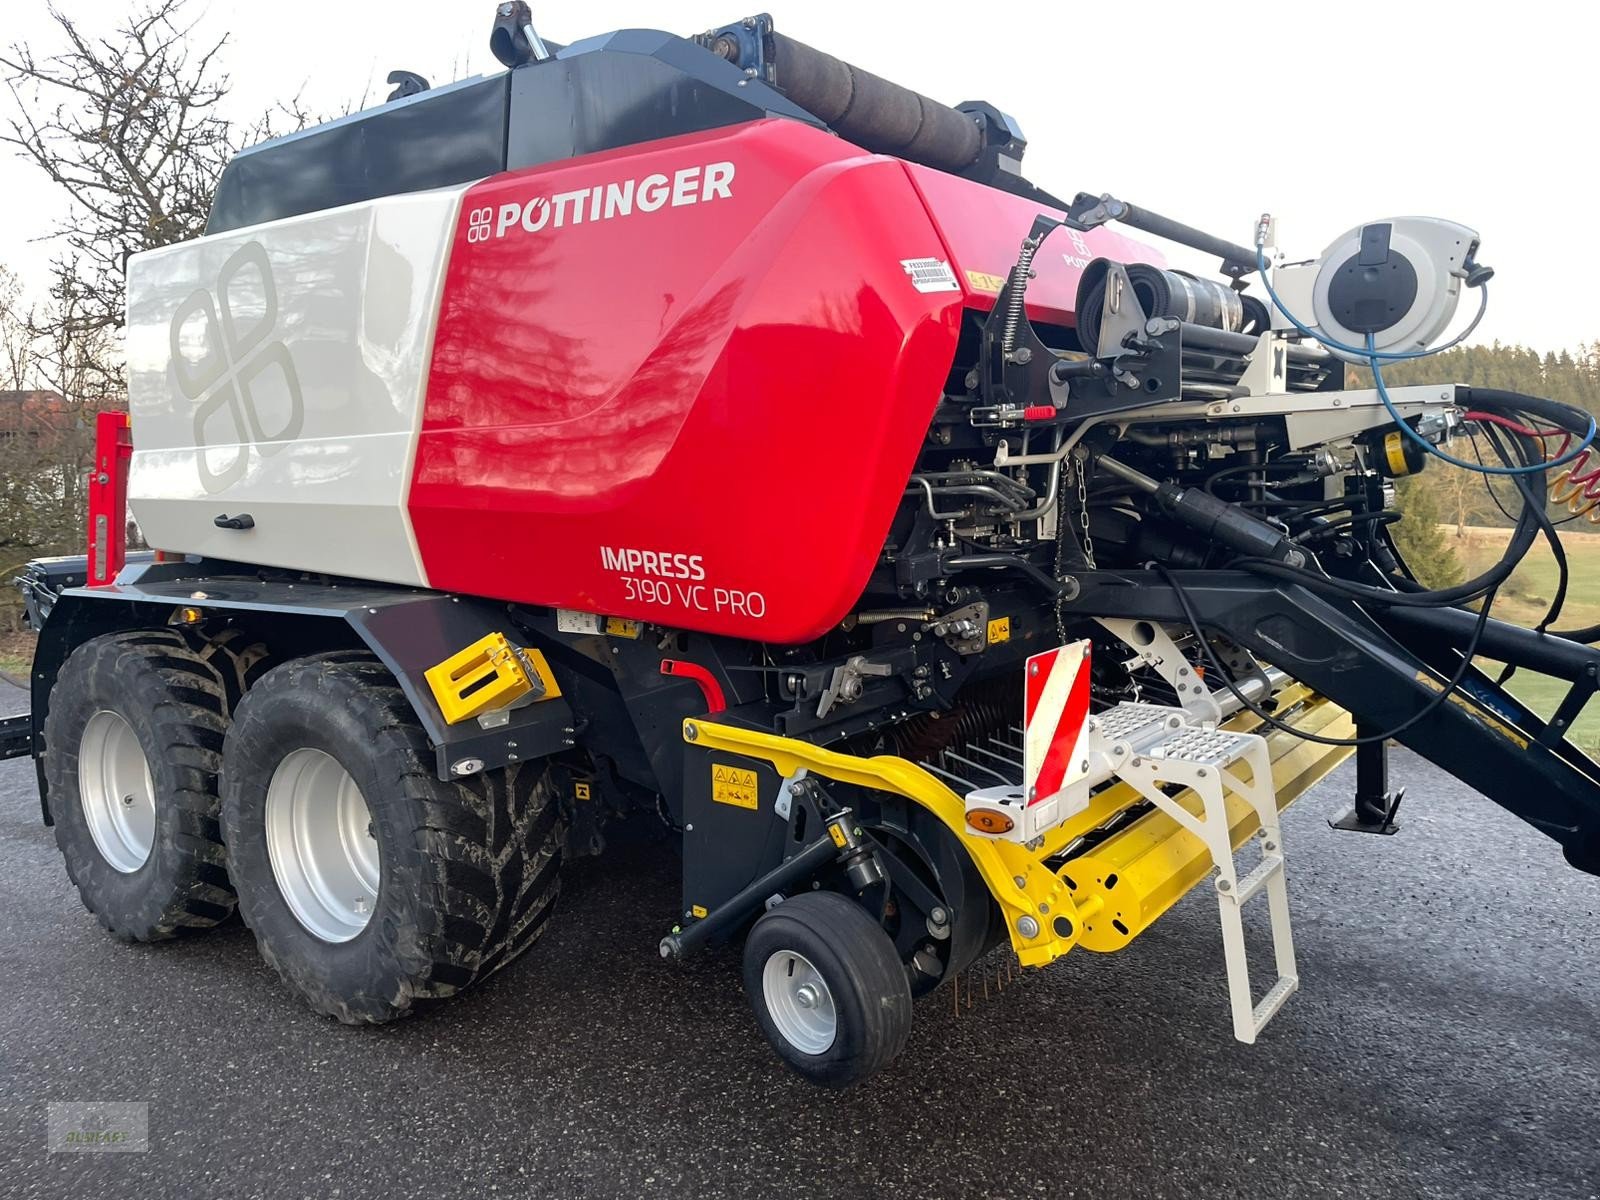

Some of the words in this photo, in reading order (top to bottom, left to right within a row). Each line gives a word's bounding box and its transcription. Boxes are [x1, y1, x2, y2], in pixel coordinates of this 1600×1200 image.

[496, 161, 735, 238] PÖTTINGER
[600, 546, 705, 580] IMPRESS
[620, 576, 671, 606] 3190
[676, 583, 708, 611] VC
[713, 588, 766, 618] PRO
